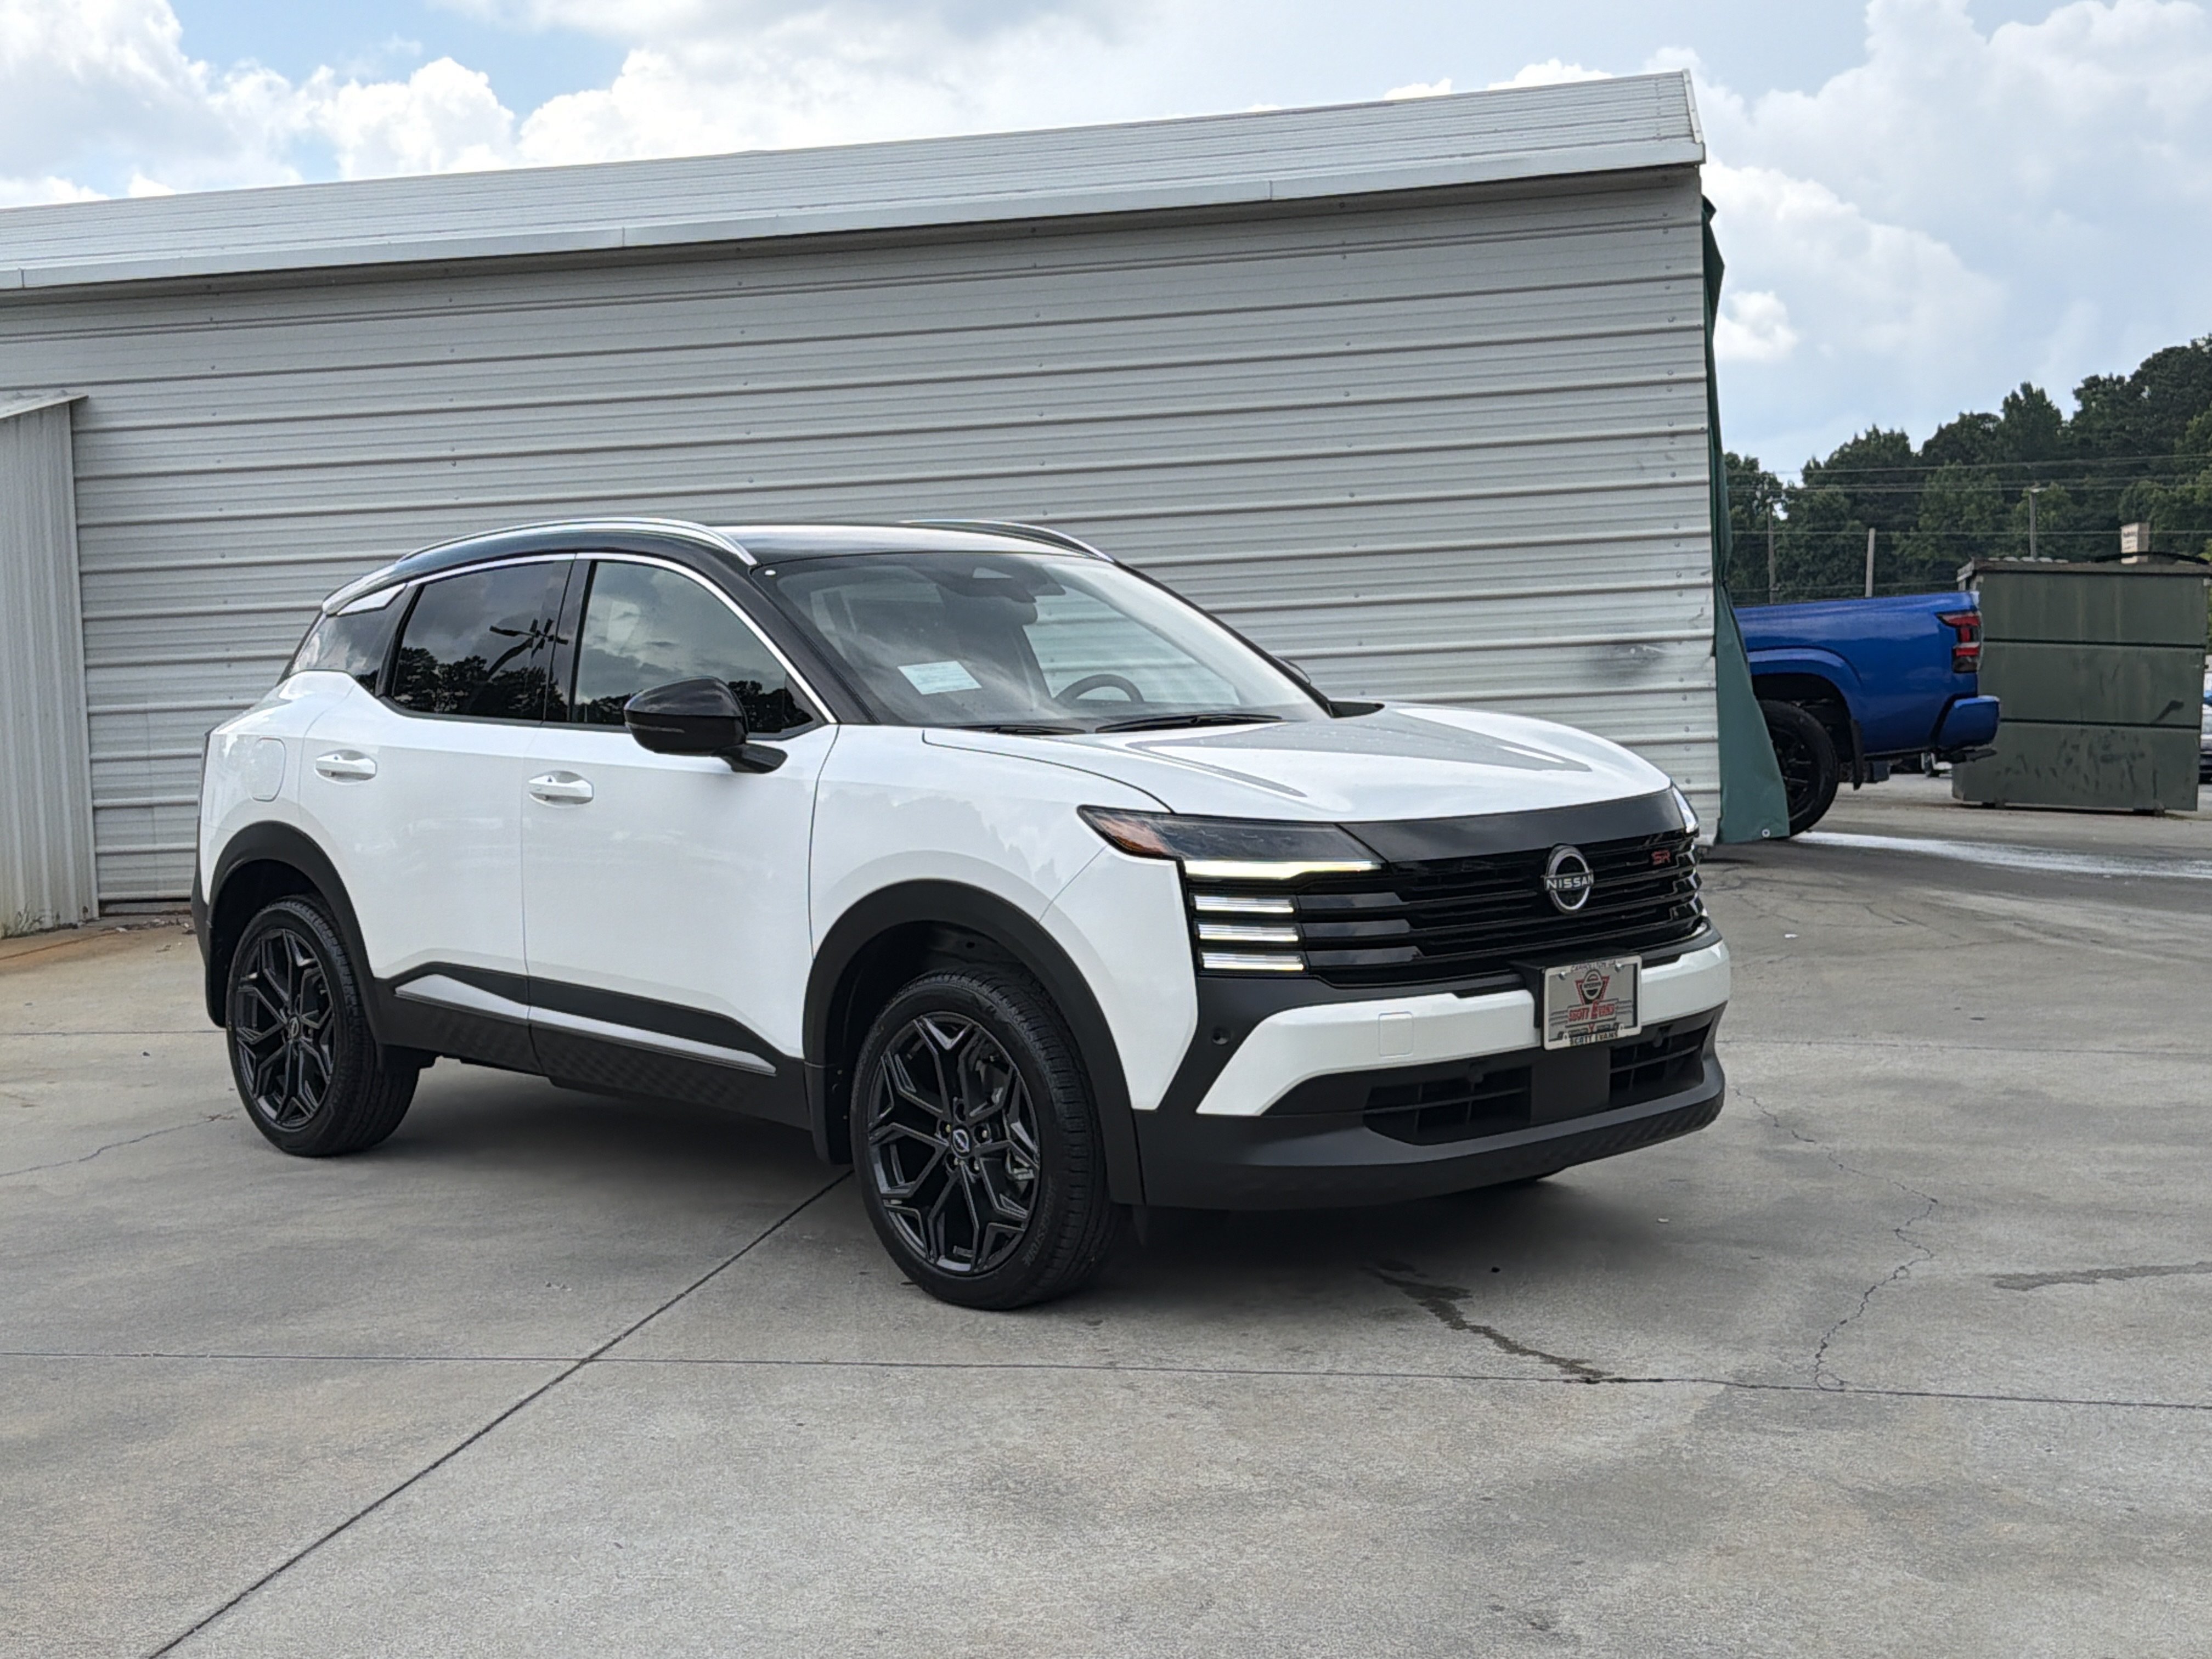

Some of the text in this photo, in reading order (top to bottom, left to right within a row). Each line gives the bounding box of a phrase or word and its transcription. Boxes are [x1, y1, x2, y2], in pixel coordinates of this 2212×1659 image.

[1651, 850, 1671, 865] SR
[1546, 875, 1594, 889] NISSAN
[1570, 1035, 1592, 1046] SCOTT
